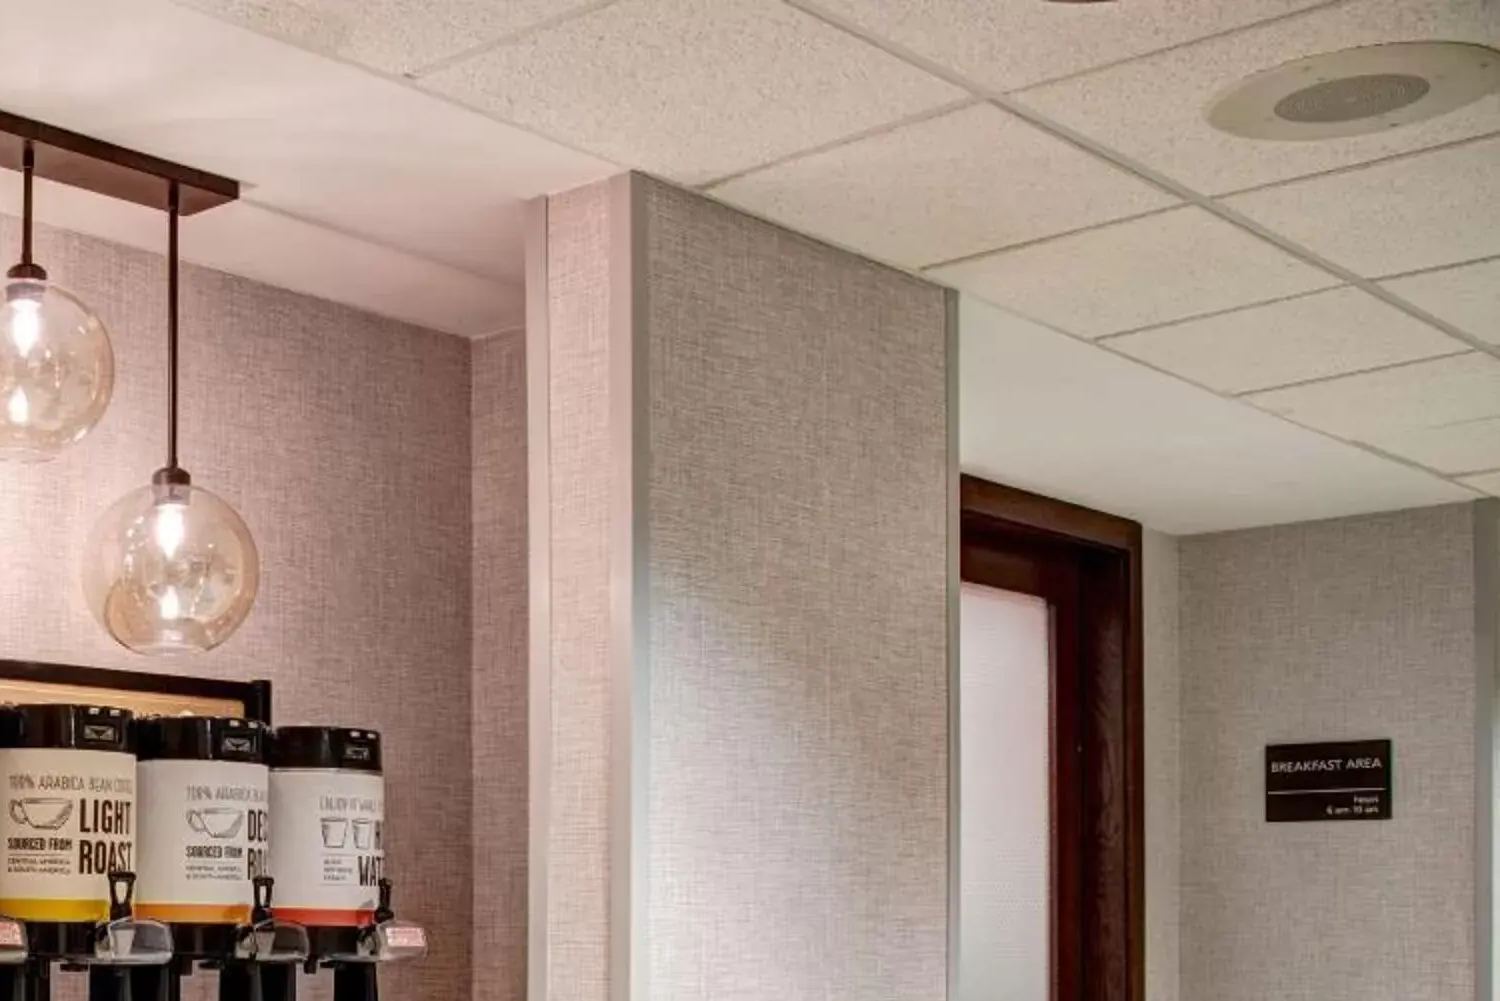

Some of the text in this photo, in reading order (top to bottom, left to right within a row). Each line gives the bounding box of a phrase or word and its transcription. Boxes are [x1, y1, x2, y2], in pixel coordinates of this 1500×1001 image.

[1271, 757, 1382, 773] BREAKFAST AREA
[38, 774, 85, 791] ARABICA
[79, 798, 132, 834] LIGHT
[48, 837, 73, 851] FROM
[79, 839, 133, 875] ROAST
